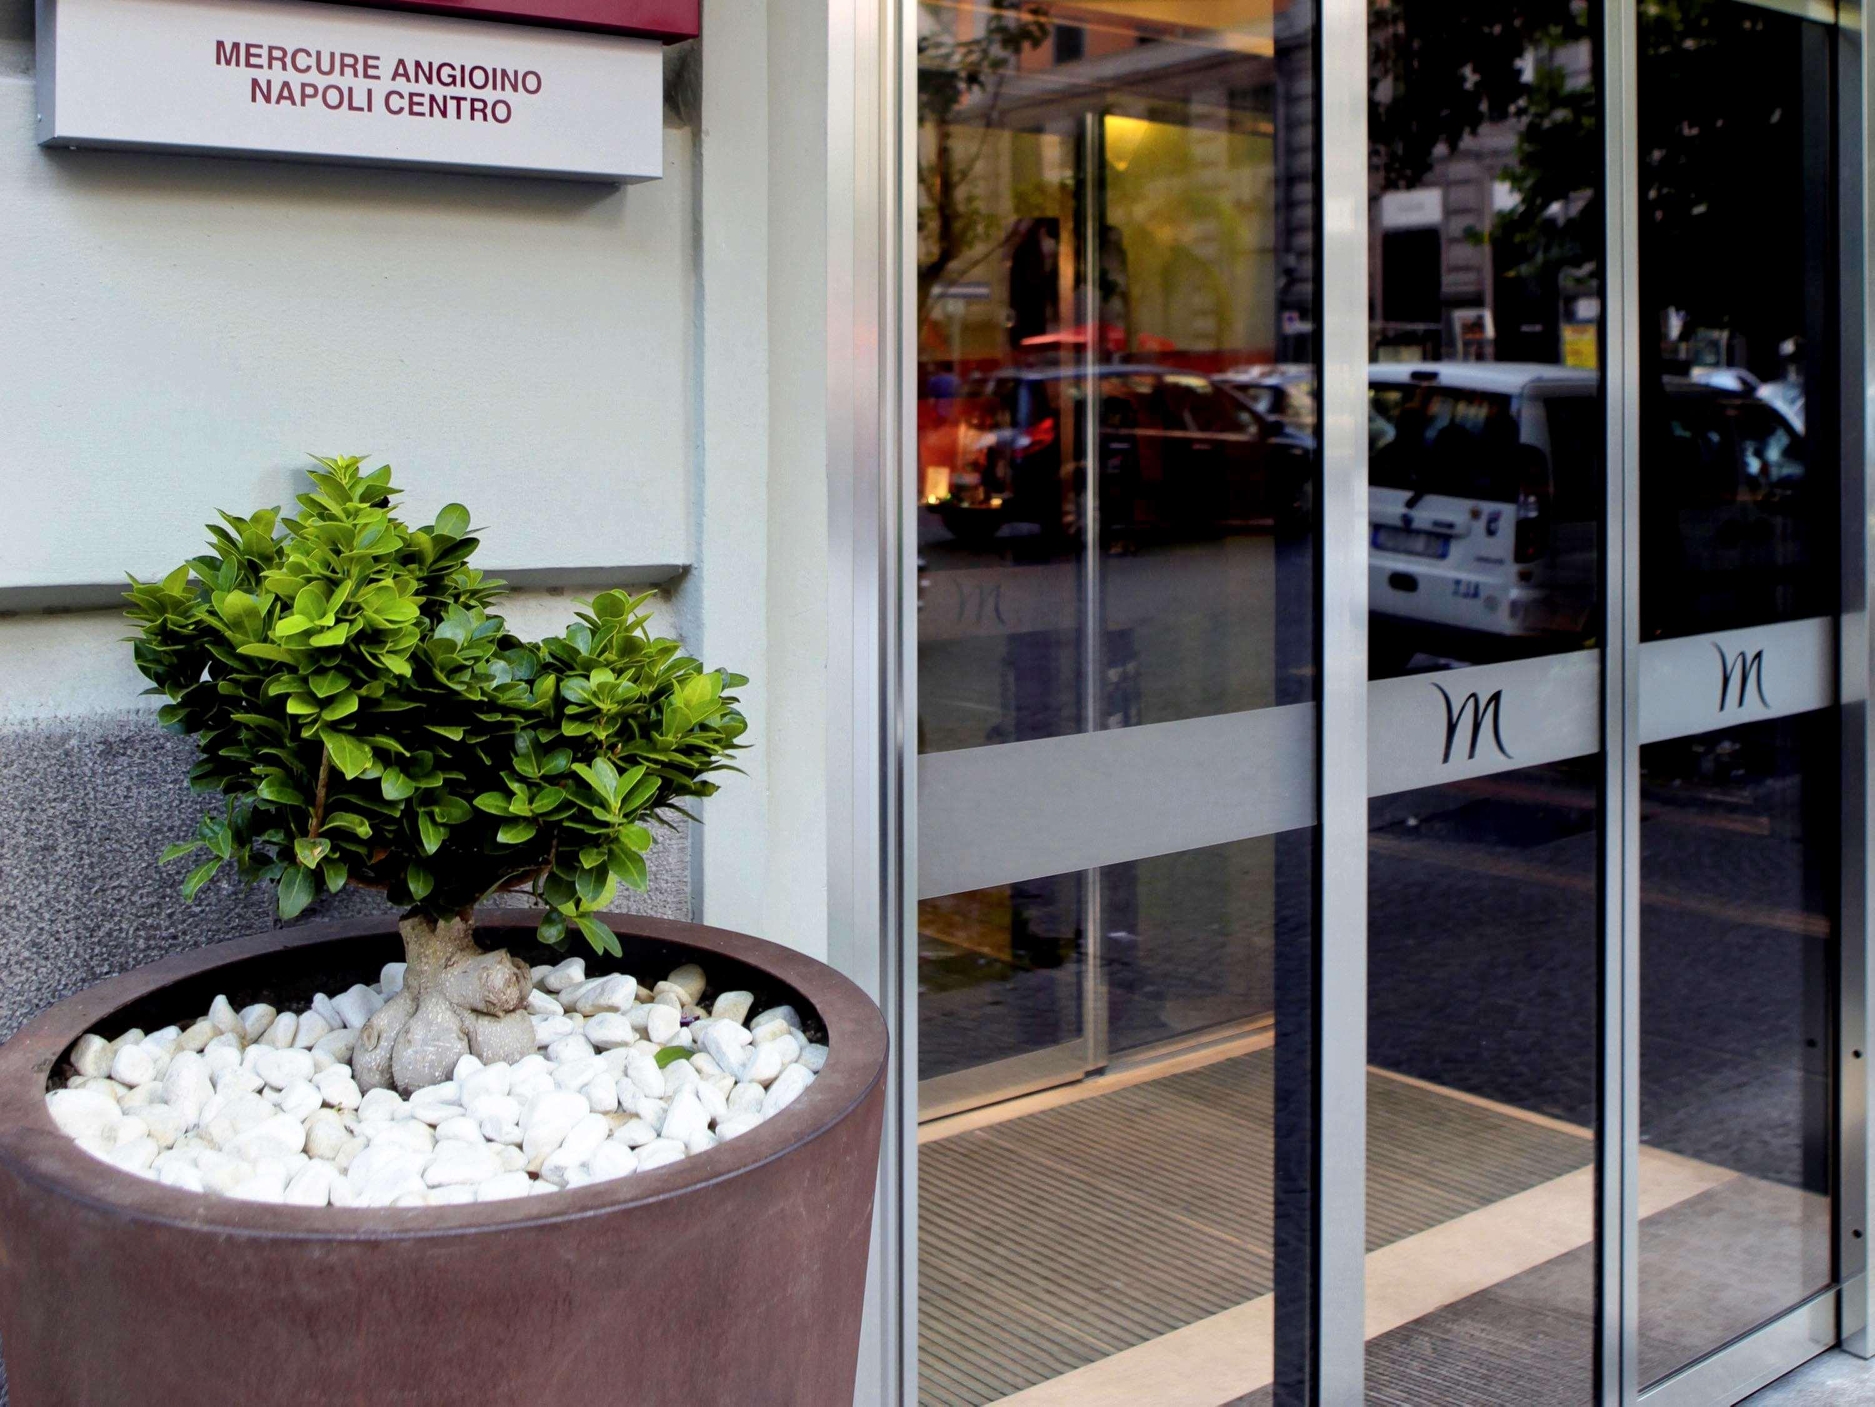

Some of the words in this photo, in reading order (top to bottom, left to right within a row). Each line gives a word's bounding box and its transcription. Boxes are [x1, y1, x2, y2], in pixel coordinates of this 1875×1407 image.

[215, 39, 381, 81] MERCURE
[390, 58, 542, 95] ANGIOINO
[251, 77, 373, 113] NAPOLI
[384, 90, 512, 124] CENTRO
